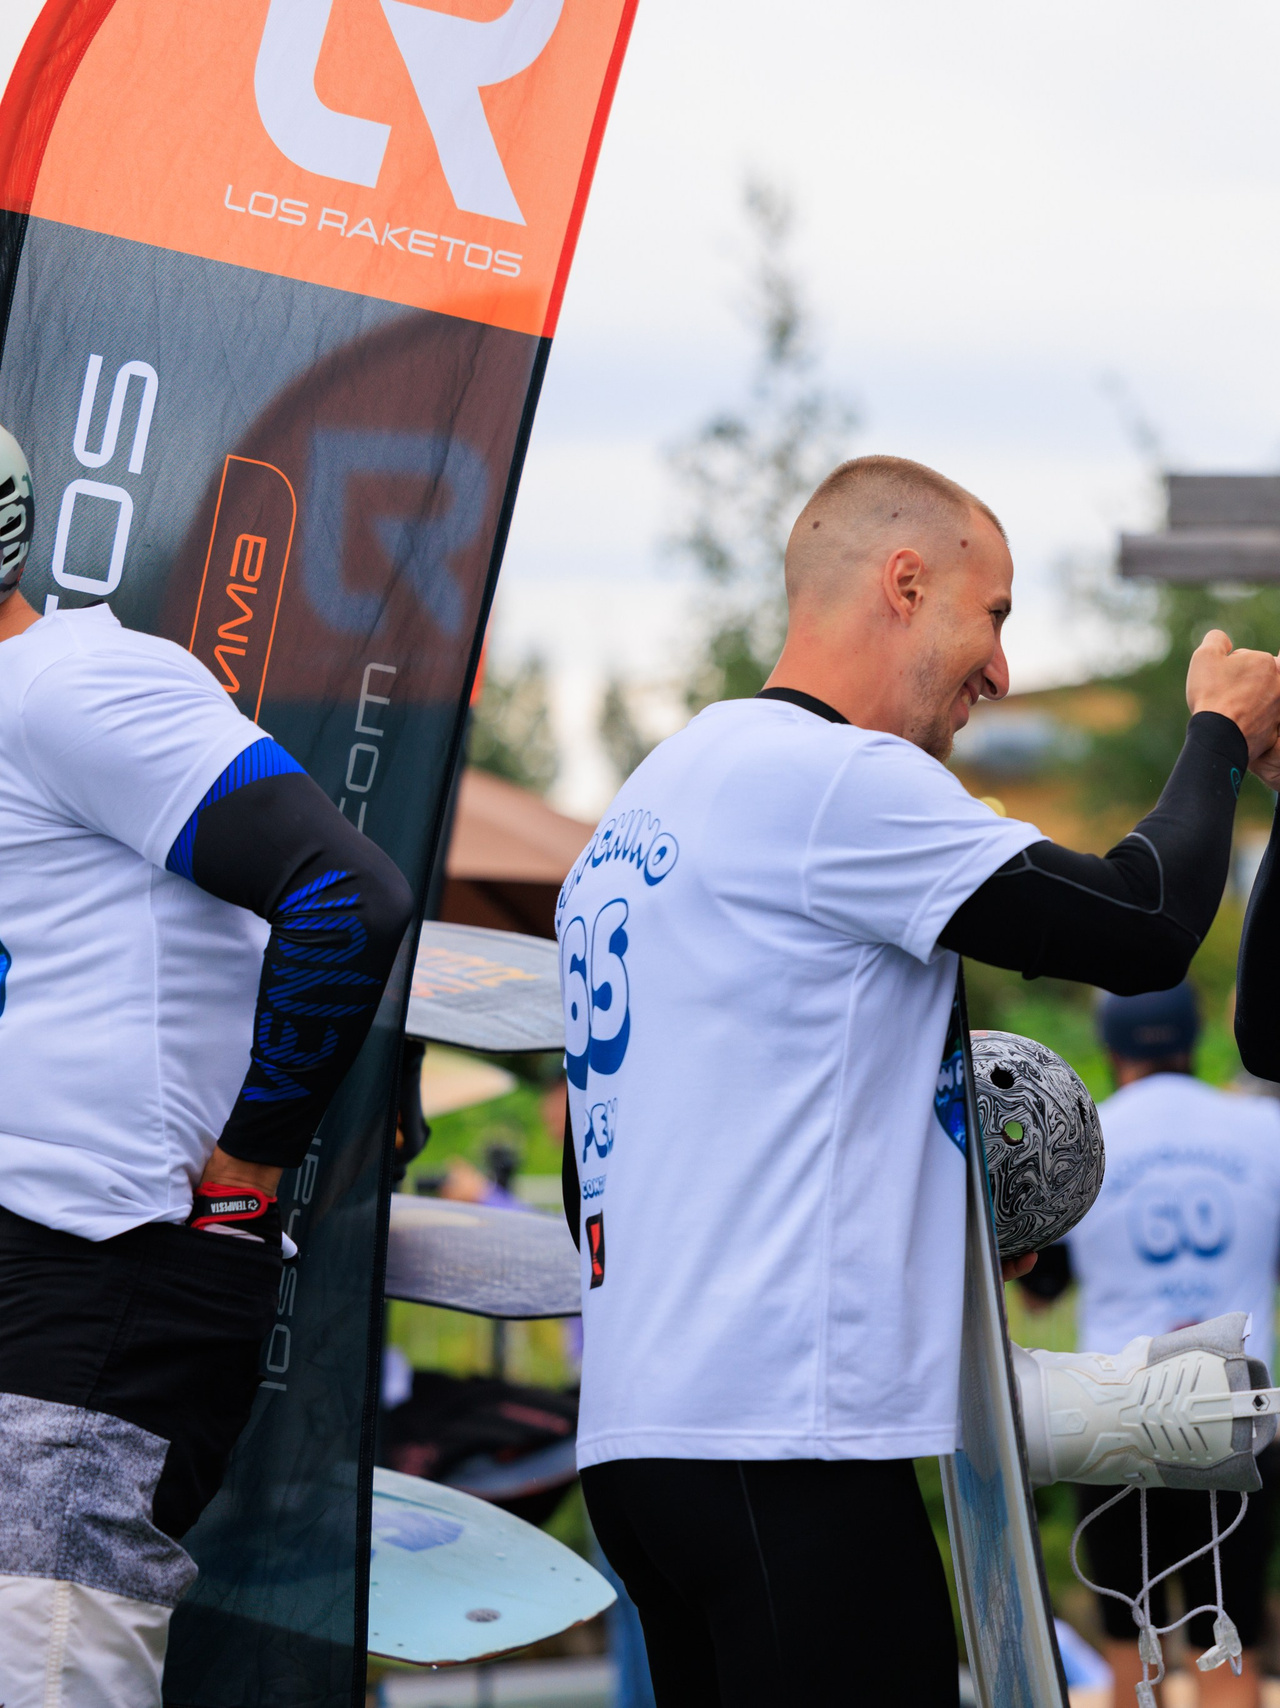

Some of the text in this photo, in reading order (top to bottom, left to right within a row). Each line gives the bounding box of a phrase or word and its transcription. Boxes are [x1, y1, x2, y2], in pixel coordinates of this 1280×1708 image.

[223, 184, 523, 278] LOS RAKETOS
[562, 897, 631, 1091] 65
[210, 1200, 247, 1214] TEMPESTA
[1127, 1180, 1238, 1264] 60
